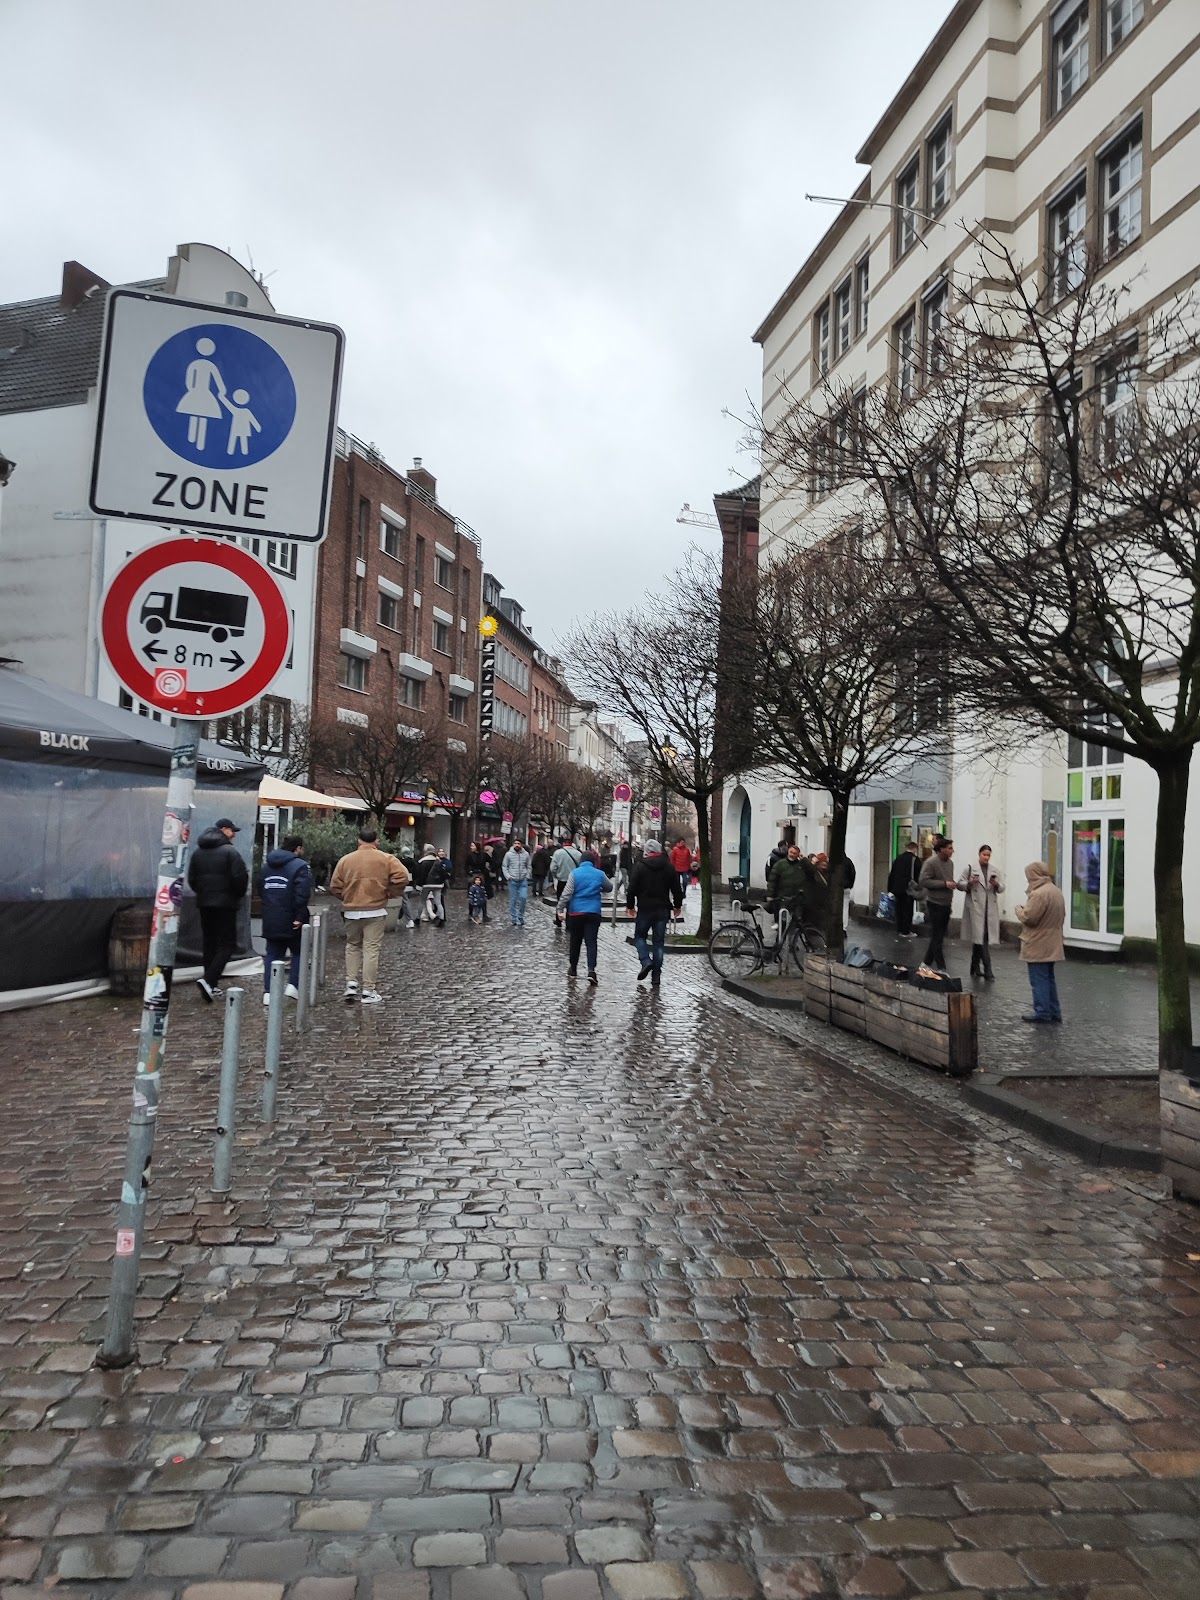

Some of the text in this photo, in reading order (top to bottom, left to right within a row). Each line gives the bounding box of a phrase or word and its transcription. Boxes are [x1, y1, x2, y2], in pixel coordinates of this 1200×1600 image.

[152, 472, 268, 519] ZONE
[174, 645, 213, 667] 8 m
[40, 730, 90, 751] BLACK
